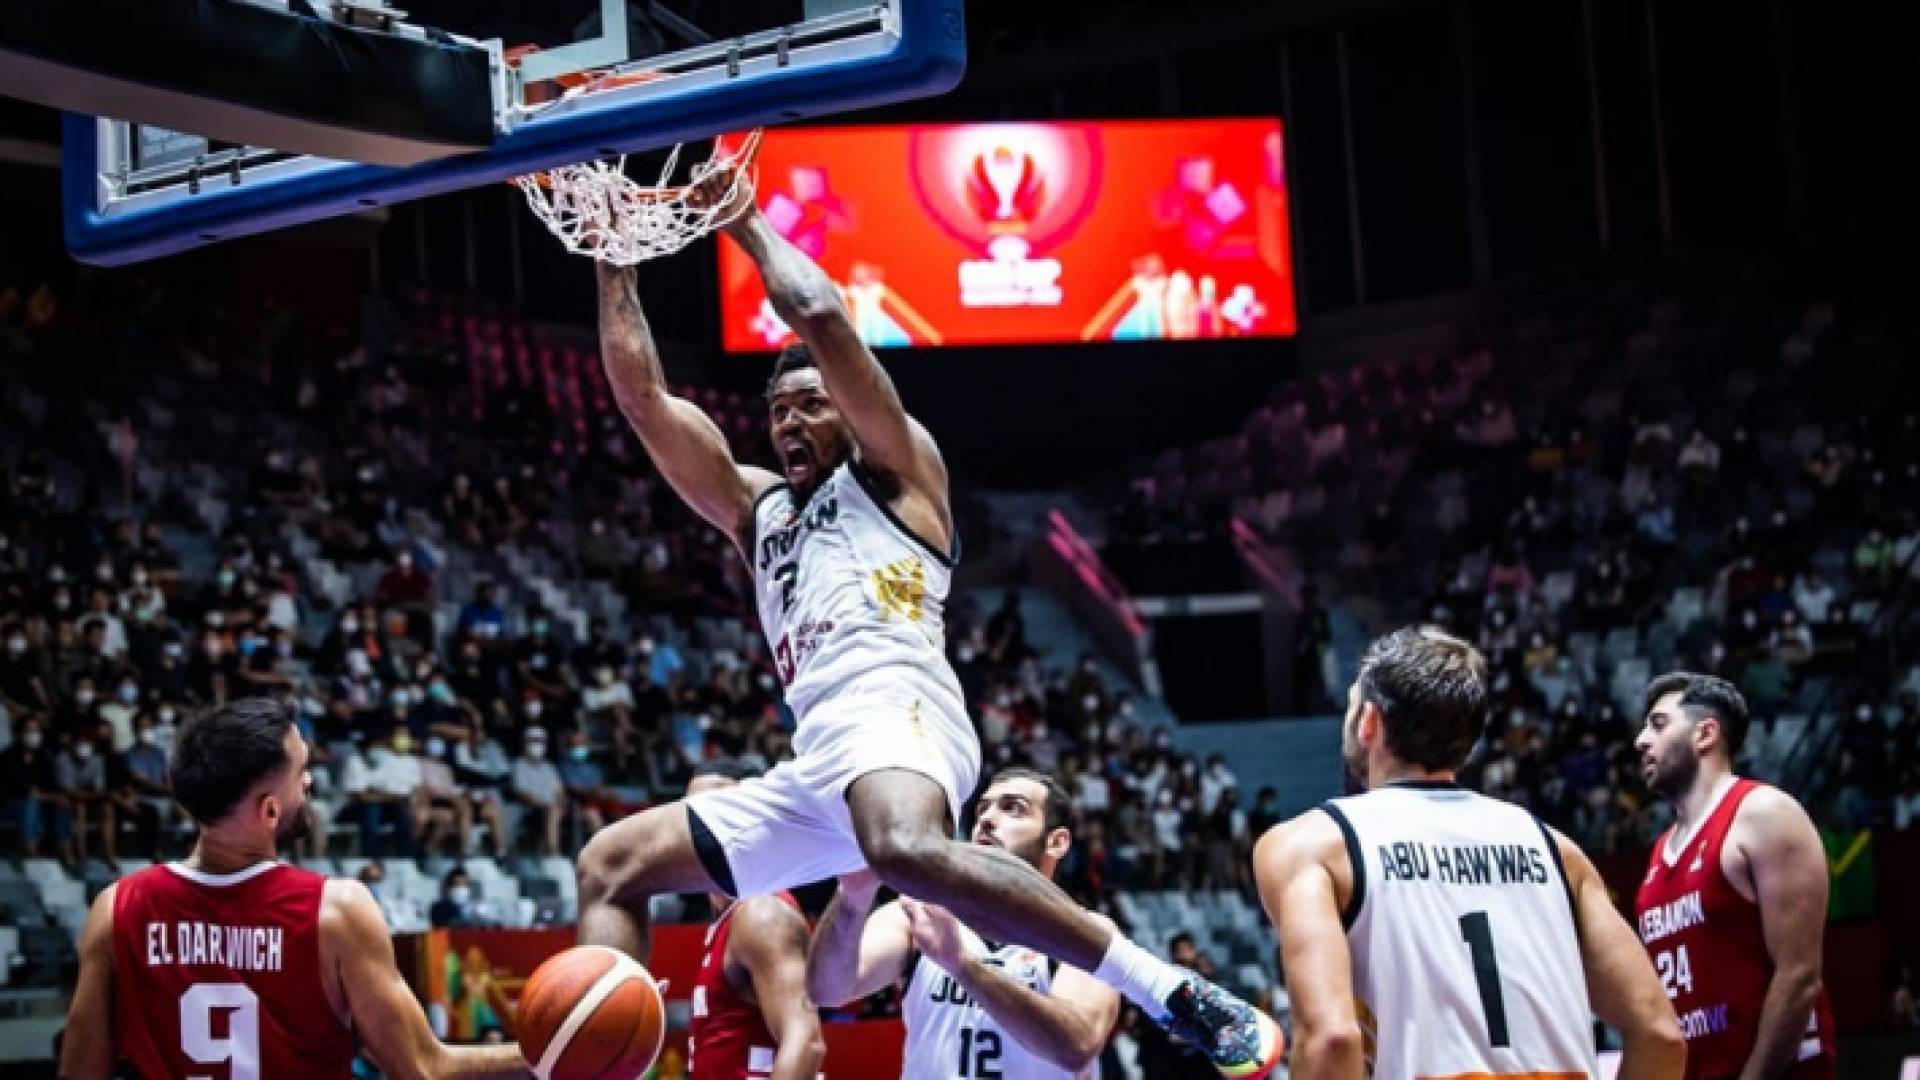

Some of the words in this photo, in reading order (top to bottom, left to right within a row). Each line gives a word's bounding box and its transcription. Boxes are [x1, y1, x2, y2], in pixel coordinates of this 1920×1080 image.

[774, 561, 799, 614] 2
[1378, 840, 1430, 881] ABU
[1433, 844, 1548, 884] HAWWAS
[146, 921, 173, 966] EL
[177, 921, 283, 972] DARWICH
[1656, 943, 1693, 1000] 24
[1458, 910, 1511, 1048] 1
[179, 982, 261, 1080] 9
[957, 1026, 1003, 1078] 12
